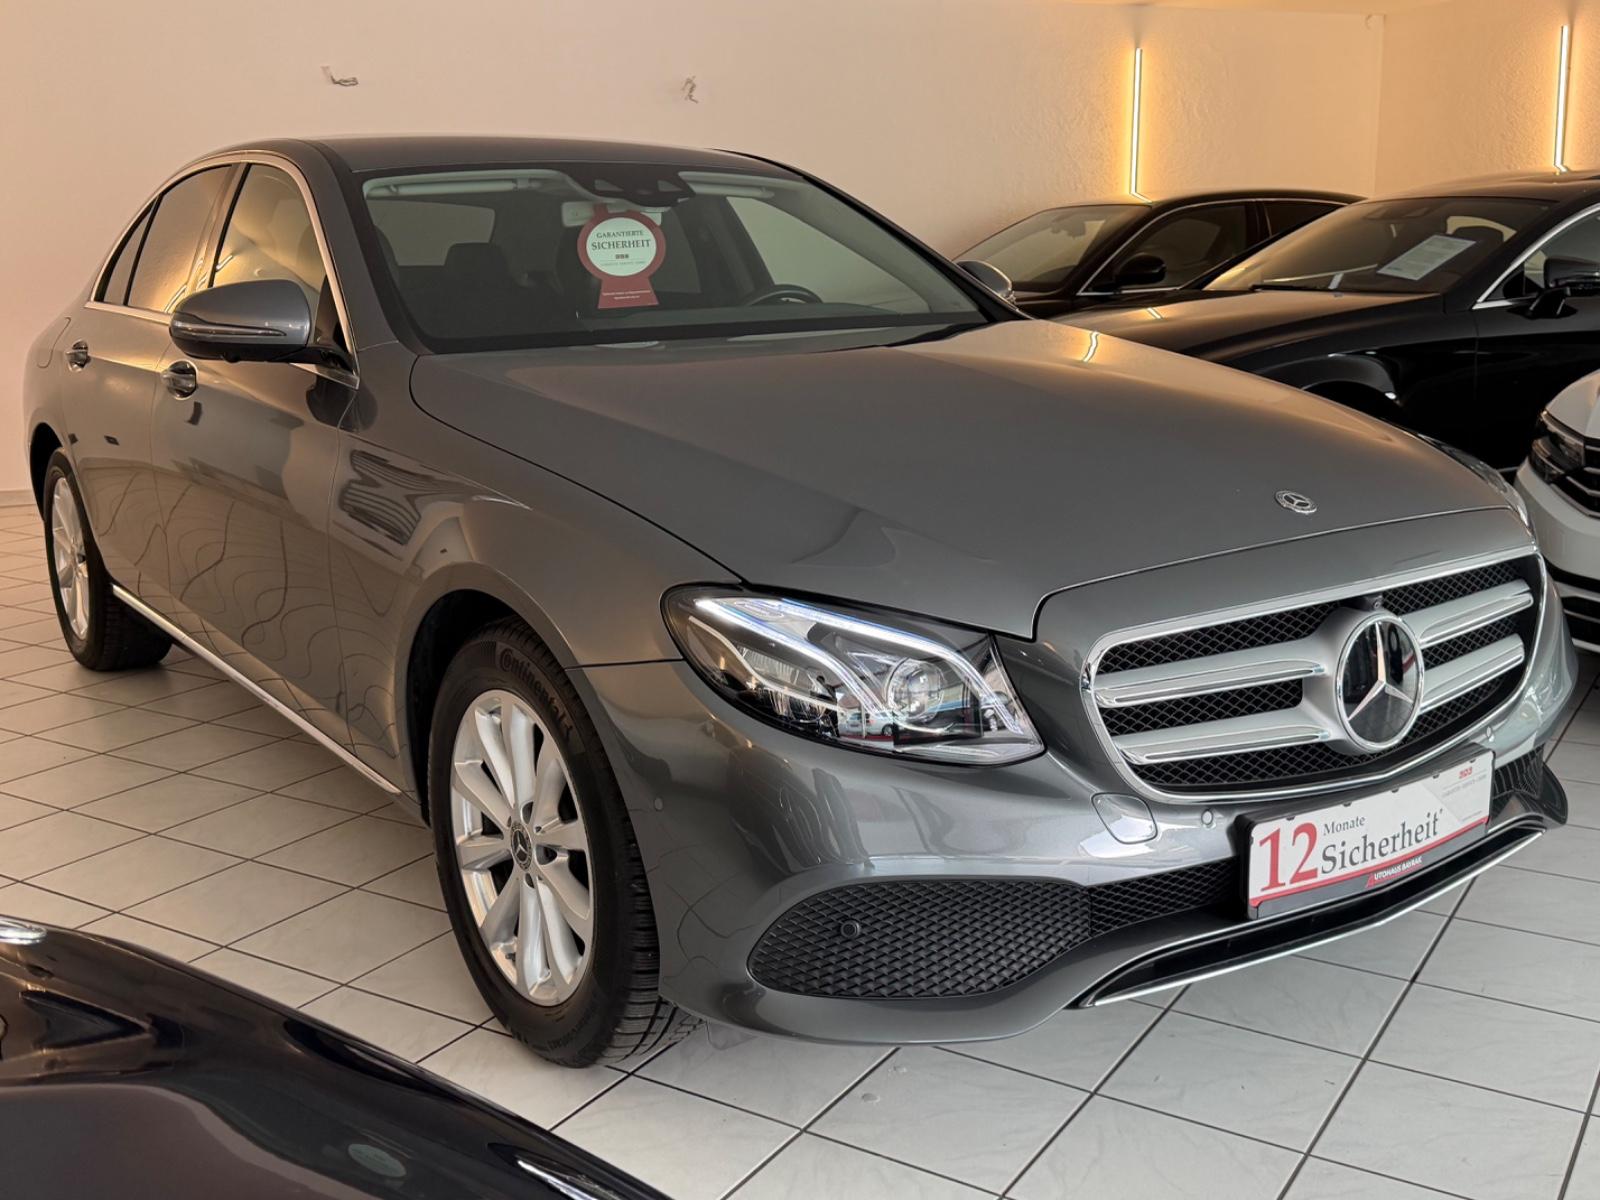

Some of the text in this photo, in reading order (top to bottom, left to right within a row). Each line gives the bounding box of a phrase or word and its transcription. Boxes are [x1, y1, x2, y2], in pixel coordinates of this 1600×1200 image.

[596, 230, 644, 238] GARANTIERTE
[591, 239, 650, 250] SICHERHEIT
[1259, 815, 1366, 892] 12 Monate
